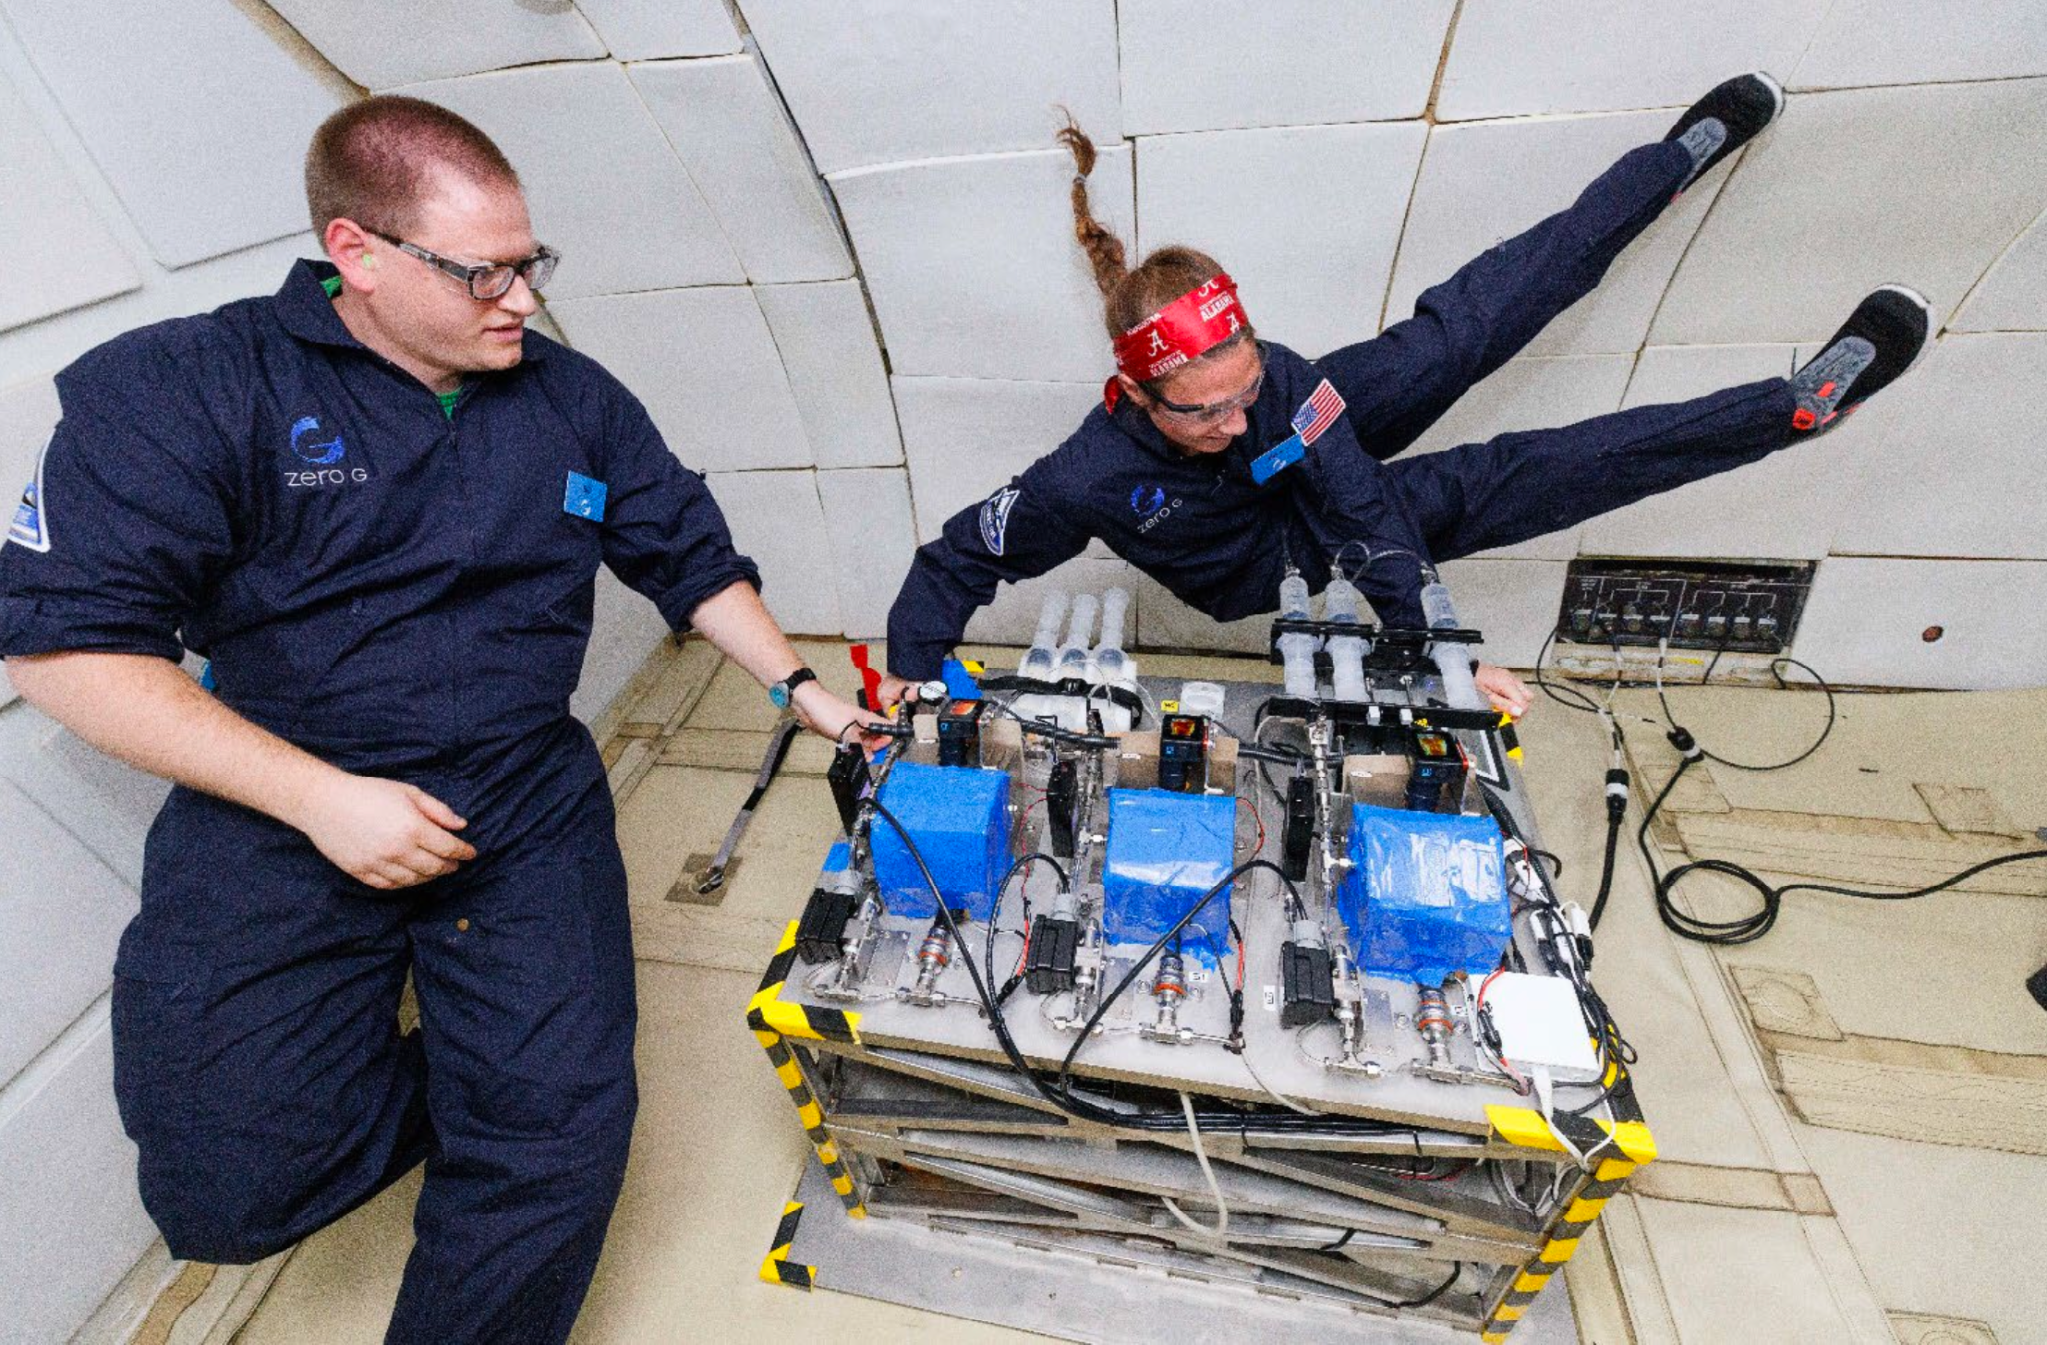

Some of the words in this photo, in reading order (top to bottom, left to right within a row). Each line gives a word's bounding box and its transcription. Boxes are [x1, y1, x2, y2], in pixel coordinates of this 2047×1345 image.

[1146, 328, 1169, 357] A
[284, 469, 345, 487] zero
[351, 468, 367, 482] G
[1137, 507, 1171, 534] zero
